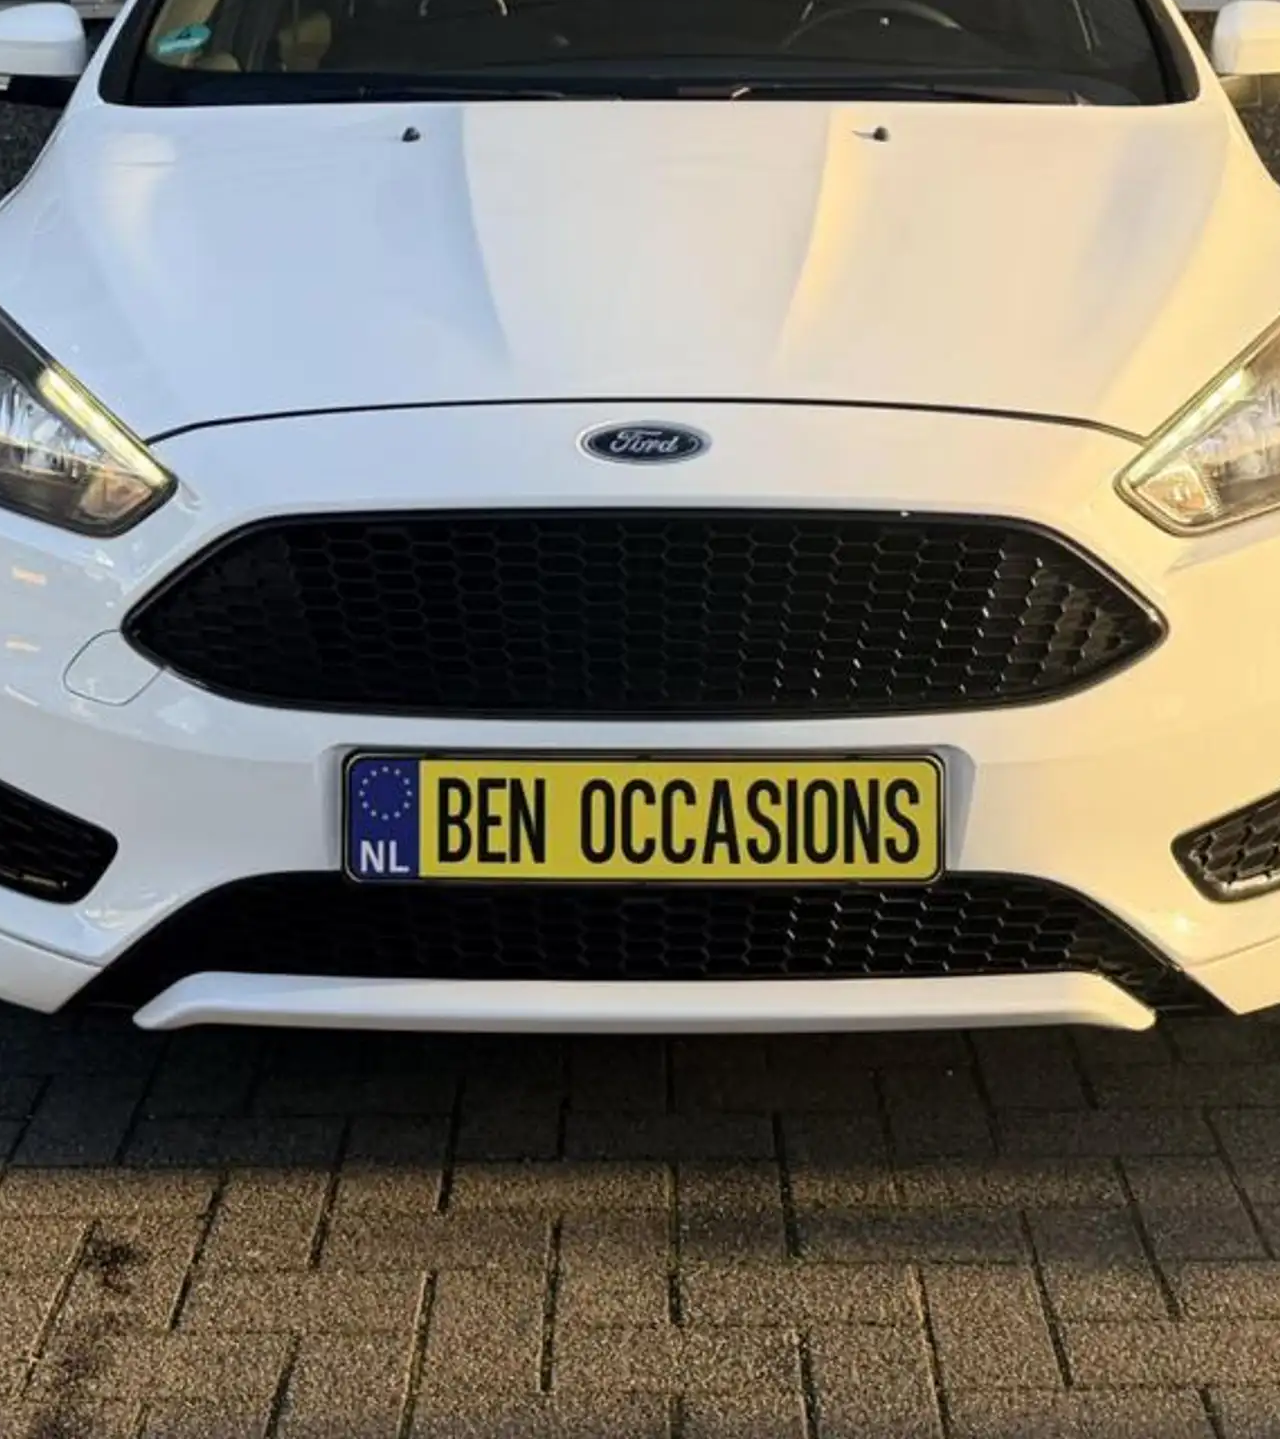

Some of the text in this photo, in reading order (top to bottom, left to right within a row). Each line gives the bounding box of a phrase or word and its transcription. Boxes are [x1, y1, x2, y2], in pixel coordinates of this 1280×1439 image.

[609, 429, 680, 454] Ford
[438, 777, 921, 864] BEN OCCASIONS
[360, 838, 410, 874] NL
